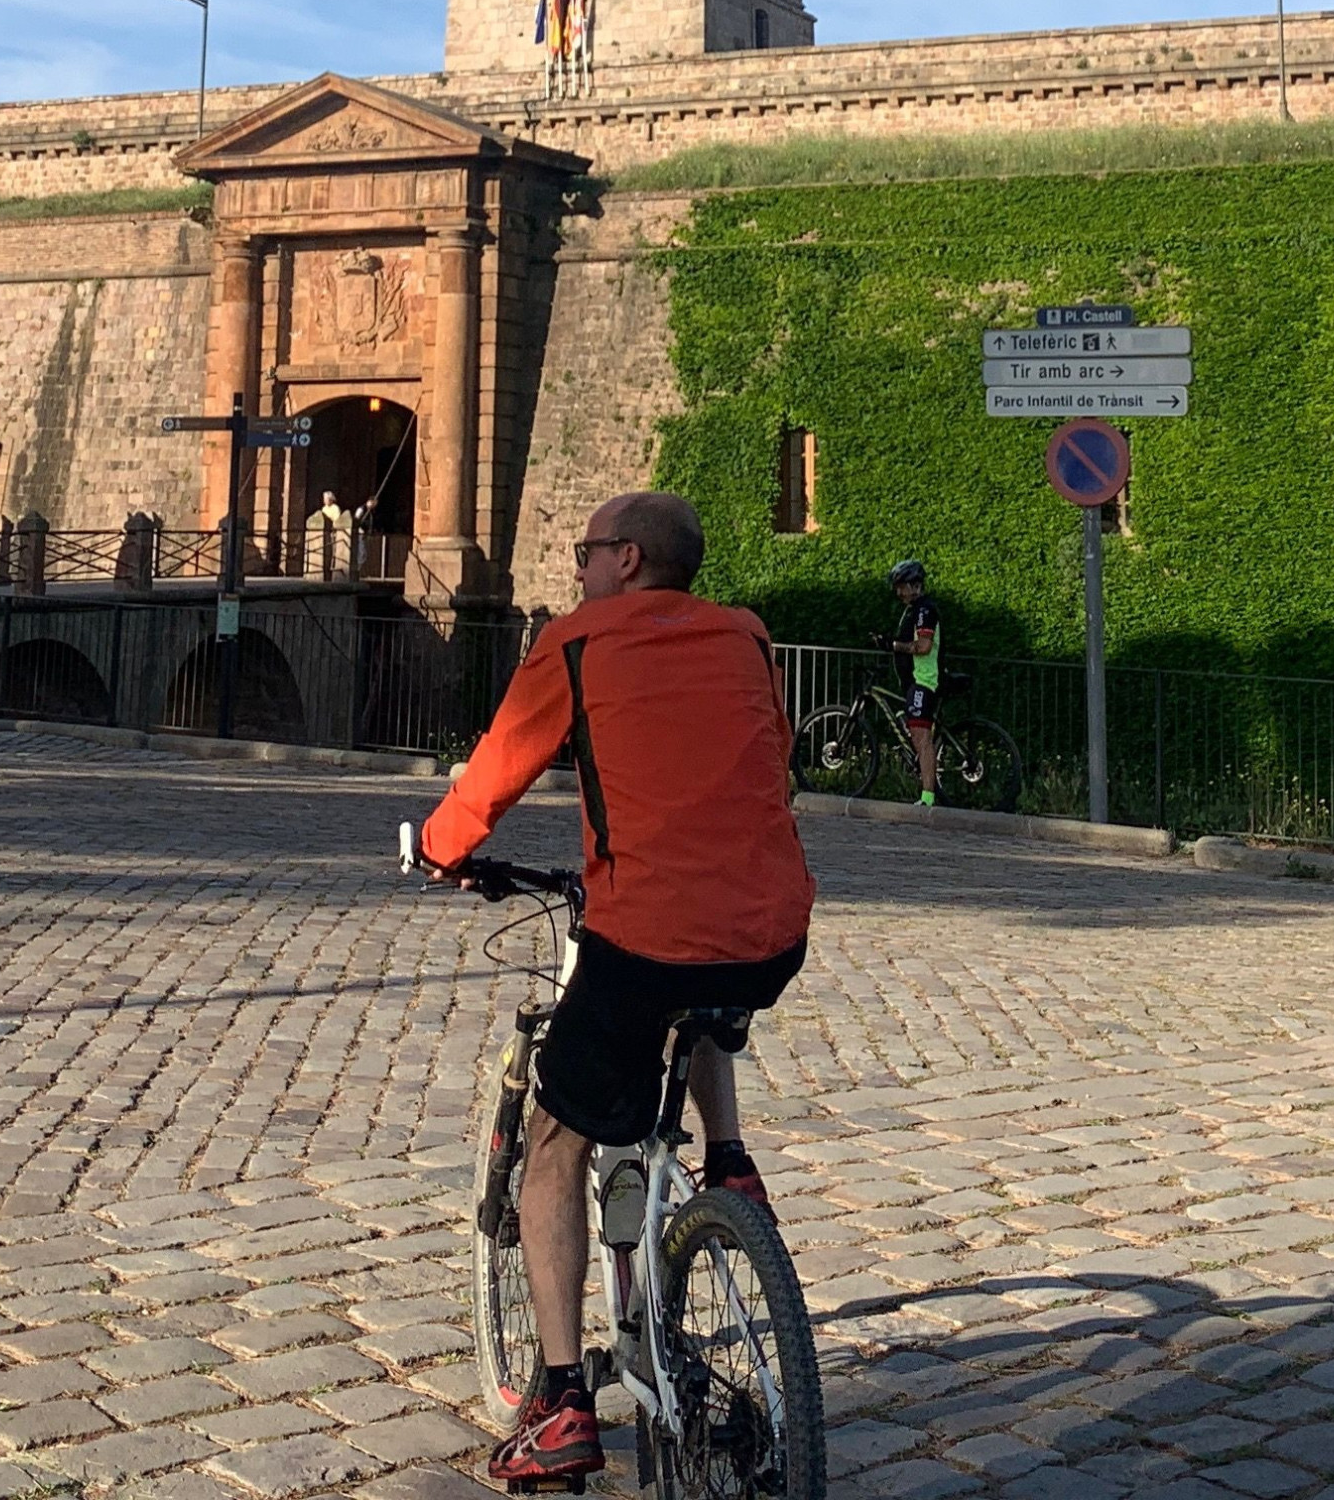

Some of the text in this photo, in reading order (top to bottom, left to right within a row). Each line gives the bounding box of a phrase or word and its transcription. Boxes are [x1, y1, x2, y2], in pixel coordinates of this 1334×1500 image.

[1082, 309, 1123, 323] Castell
[1010, 332, 1077, 350] Telefèric
[1010, 363, 1104, 379] Tir amb arc
[994, 393, 1143, 407] Parc Infantil de Trànsit
